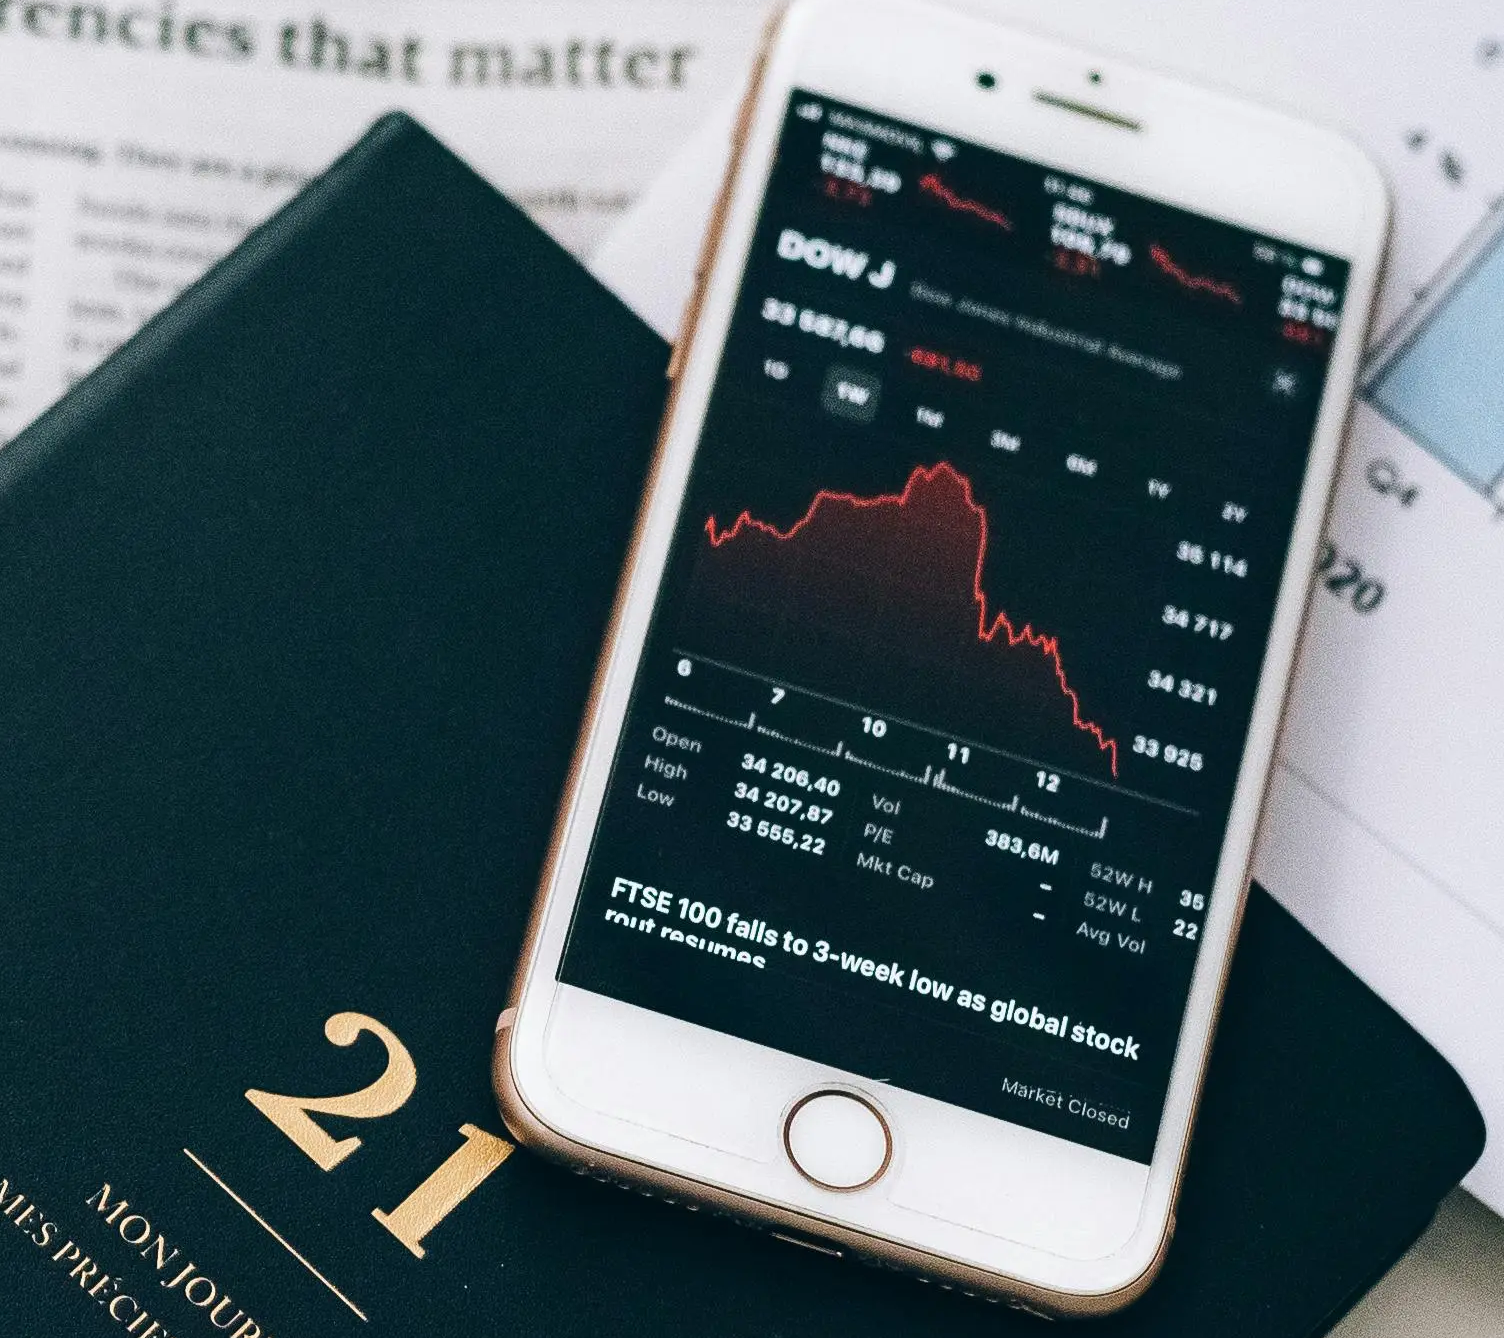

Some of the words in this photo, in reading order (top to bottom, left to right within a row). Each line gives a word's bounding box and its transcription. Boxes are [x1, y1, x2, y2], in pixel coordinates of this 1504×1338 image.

[280, 16, 427, 86] that
[448, 33, 697, 91] matter
[775, 228, 869, 280] DOW
[866, 259, 896, 289] J
[1365, 459, 1422, 510] Q4
[1160, 604, 1190, 628] 34
[769, 686, 786, 705] 7
[1146, 668, 1175, 693] 34
[650, 724, 702, 753] Open
[861, 715, 887, 738] 10
[946, 741, 970, 765] 11
[1131, 734, 1160, 758] 33
[642, 753, 688, 780] High
[740, 752, 768, 774] 34
[769, 761, 841, 797] 206,40
[1035, 769, 1061, 793] 12
[635, 782, 675, 807] Low
[732, 780, 760, 803] 34
[762, 790, 834, 825] 207,87
[871, 792, 901, 816] Vol
[725, 809, 753, 832] 33
[755, 819, 826, 856] 555,22
[862, 821, 894, 845] P/E
[983, 828, 1060, 866] 383,6M
[855, 850, 893, 876] Mkt
[895, 863, 935, 890] Cap
[1089, 861, 1134, 888] 52W
[1136, 876, 1153, 894] H
[1082, 890, 1128, 917] 52W
[1129, 905, 1141, 923] L
[1074, 920, 1111, 947] Avg
[1116, 931, 1146, 954] Vol
[609, 875, 674, 915] FTSE
[678, 896, 723, 929] 100
[726, 912, 779, 948] falls
[782, 929, 810, 959] to
[811, 938, 905, 988] 3-week
[907, 967, 955, 1002] low
[955, 988, 987, 1012] as
[988, 997, 1069, 1038] global
[1069, 1023, 1140, 1061] stock
[1000, 1076, 1064, 1110] Market
[1066, 1097, 1131, 1130] Closed
[245, 1011, 516, 1259] 21
[84, 1181, 180, 1270] MON
